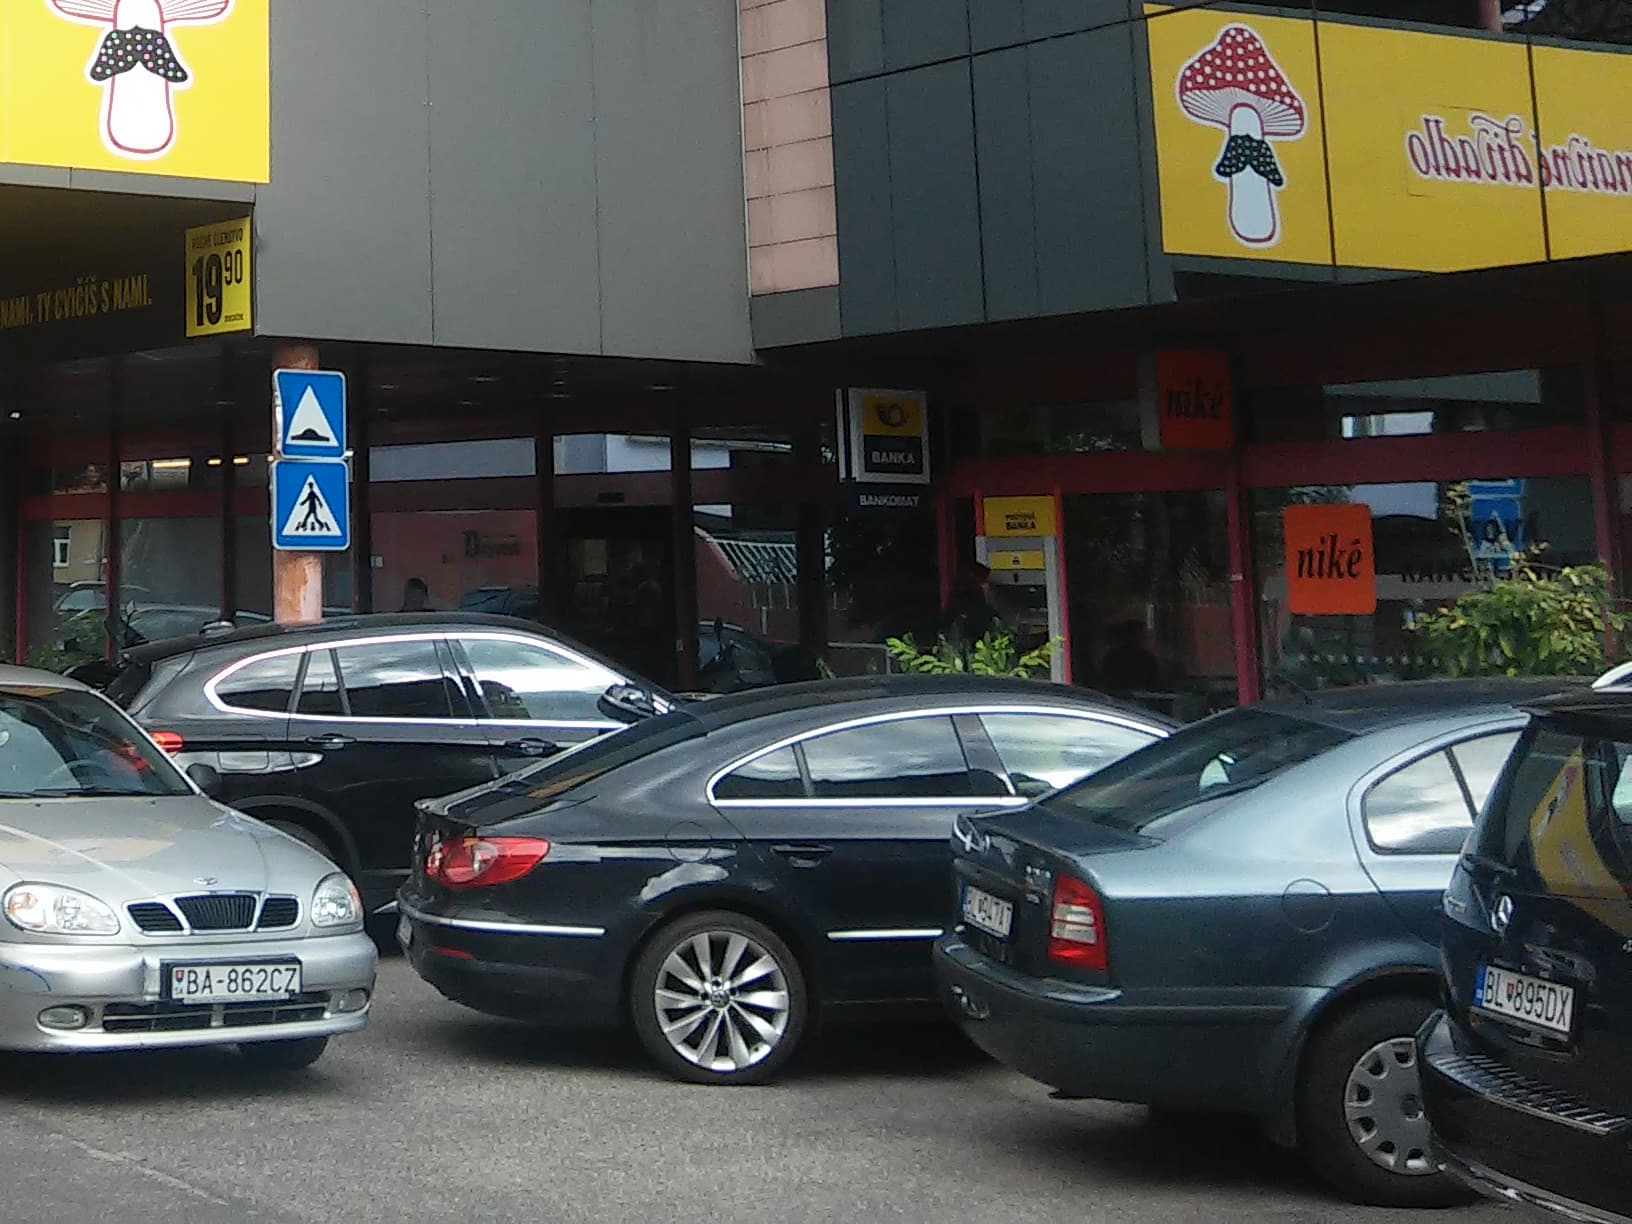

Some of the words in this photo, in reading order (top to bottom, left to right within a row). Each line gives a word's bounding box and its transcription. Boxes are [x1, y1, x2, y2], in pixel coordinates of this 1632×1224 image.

[36, 291, 51, 323] TY
[100, 280, 110, 313] S
[871, 450, 916, 465] BANKA
[858, 494, 920, 507] BANKOMAT
[1297, 534, 1363, 579] niké
[187, 968, 298, 995] BA-862CZ
